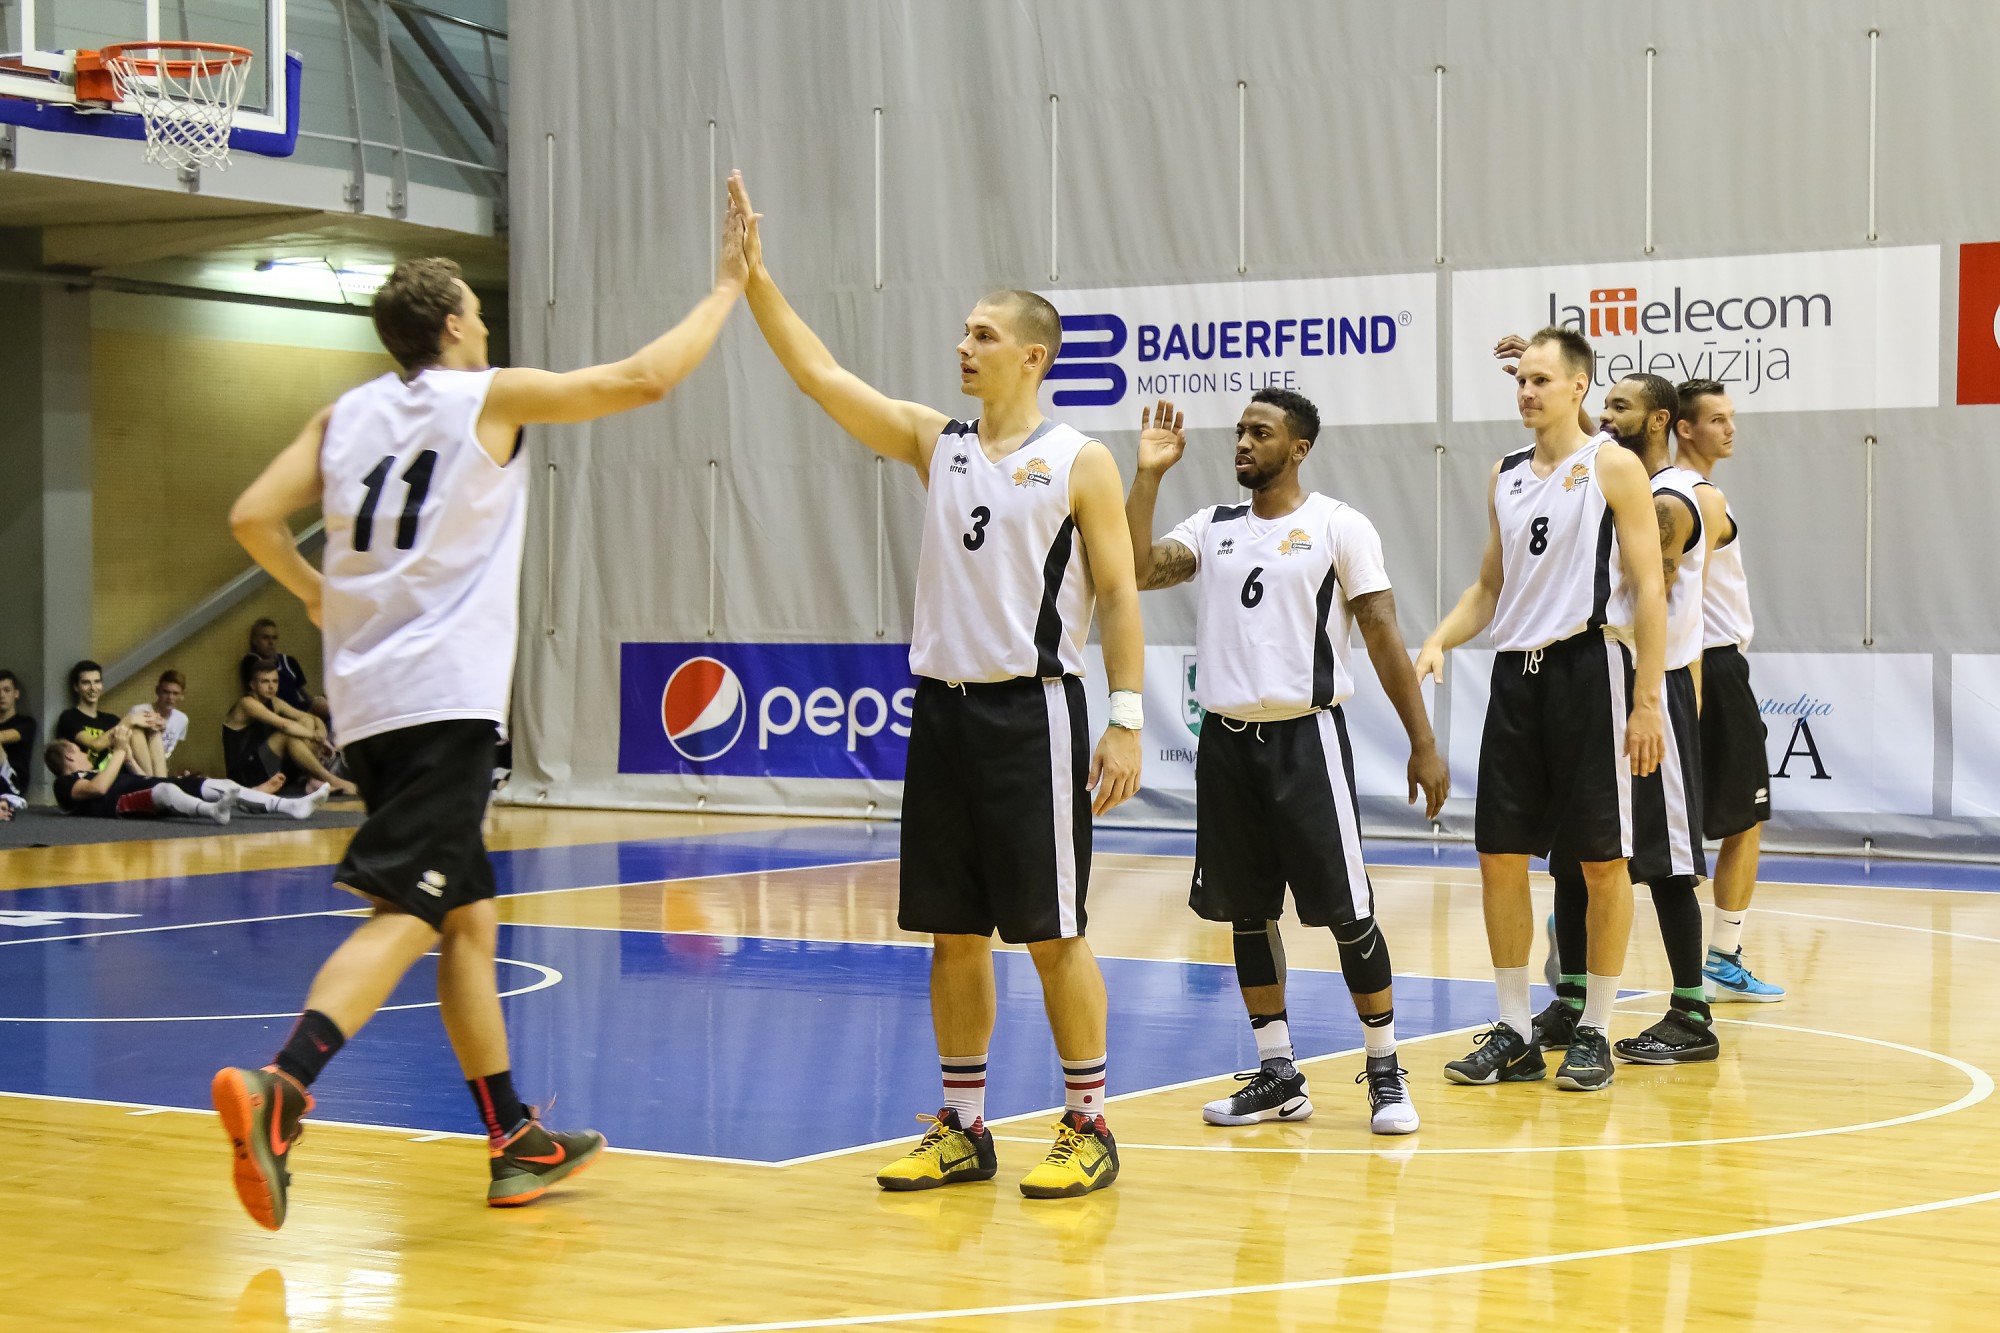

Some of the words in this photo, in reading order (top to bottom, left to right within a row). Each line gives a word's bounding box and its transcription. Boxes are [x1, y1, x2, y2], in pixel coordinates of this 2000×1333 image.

[1137, 314, 1397, 362] BAUERFEIND
[1137, 373, 1217, 395] MOTION
[1223, 372, 1242, 392] IS
[354, 449, 438, 553] 11
[963, 505, 991, 551] 3
[1529, 516, 1549, 556] 8
[1240, 566, 1265, 609] 6
[759, 686, 917, 752] peps
